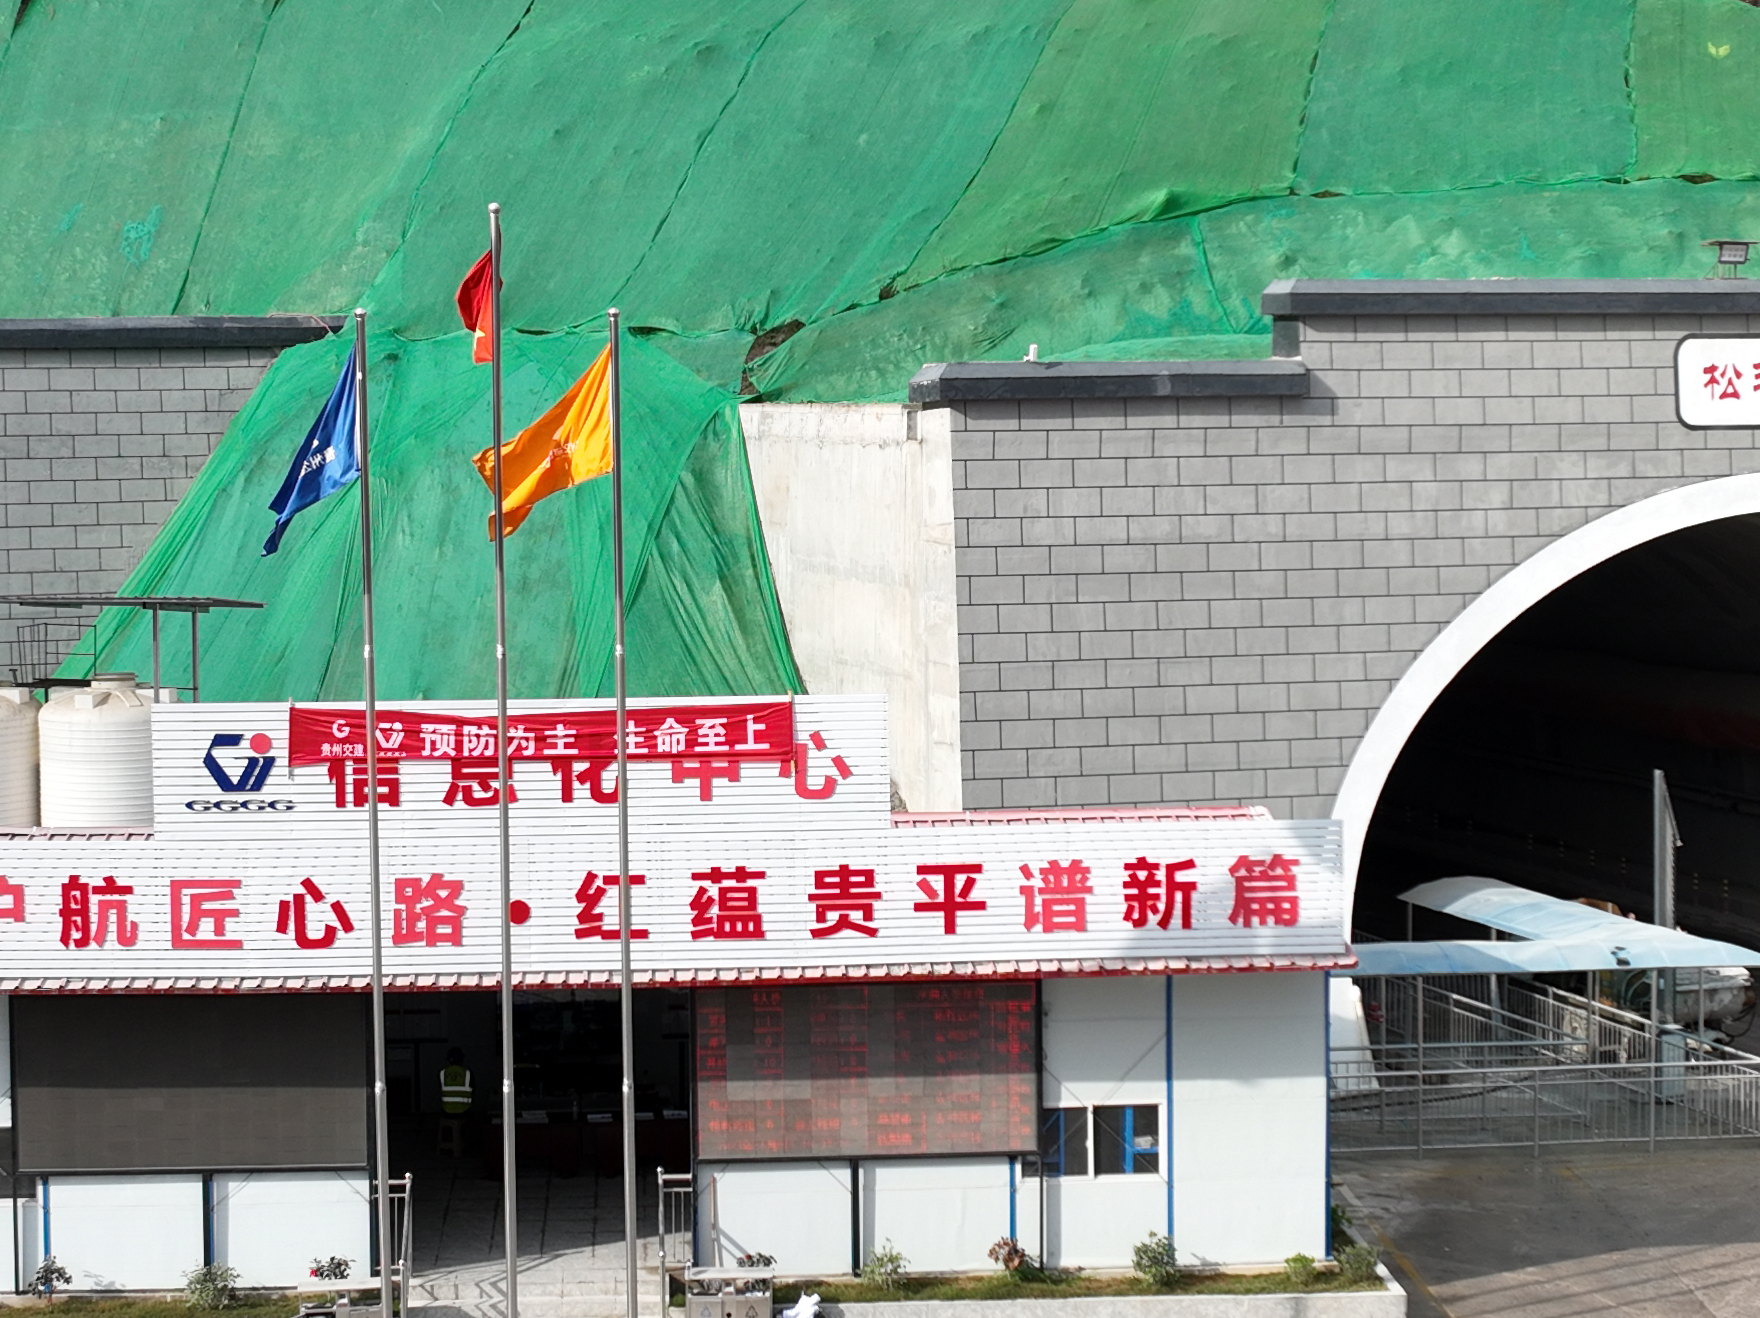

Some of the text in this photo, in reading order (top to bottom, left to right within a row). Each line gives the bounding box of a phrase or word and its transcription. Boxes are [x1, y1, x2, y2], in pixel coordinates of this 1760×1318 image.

[321, 743, 365, 757] 贵州交建
[420, 715, 770, 757] 预防为主 生命至上
